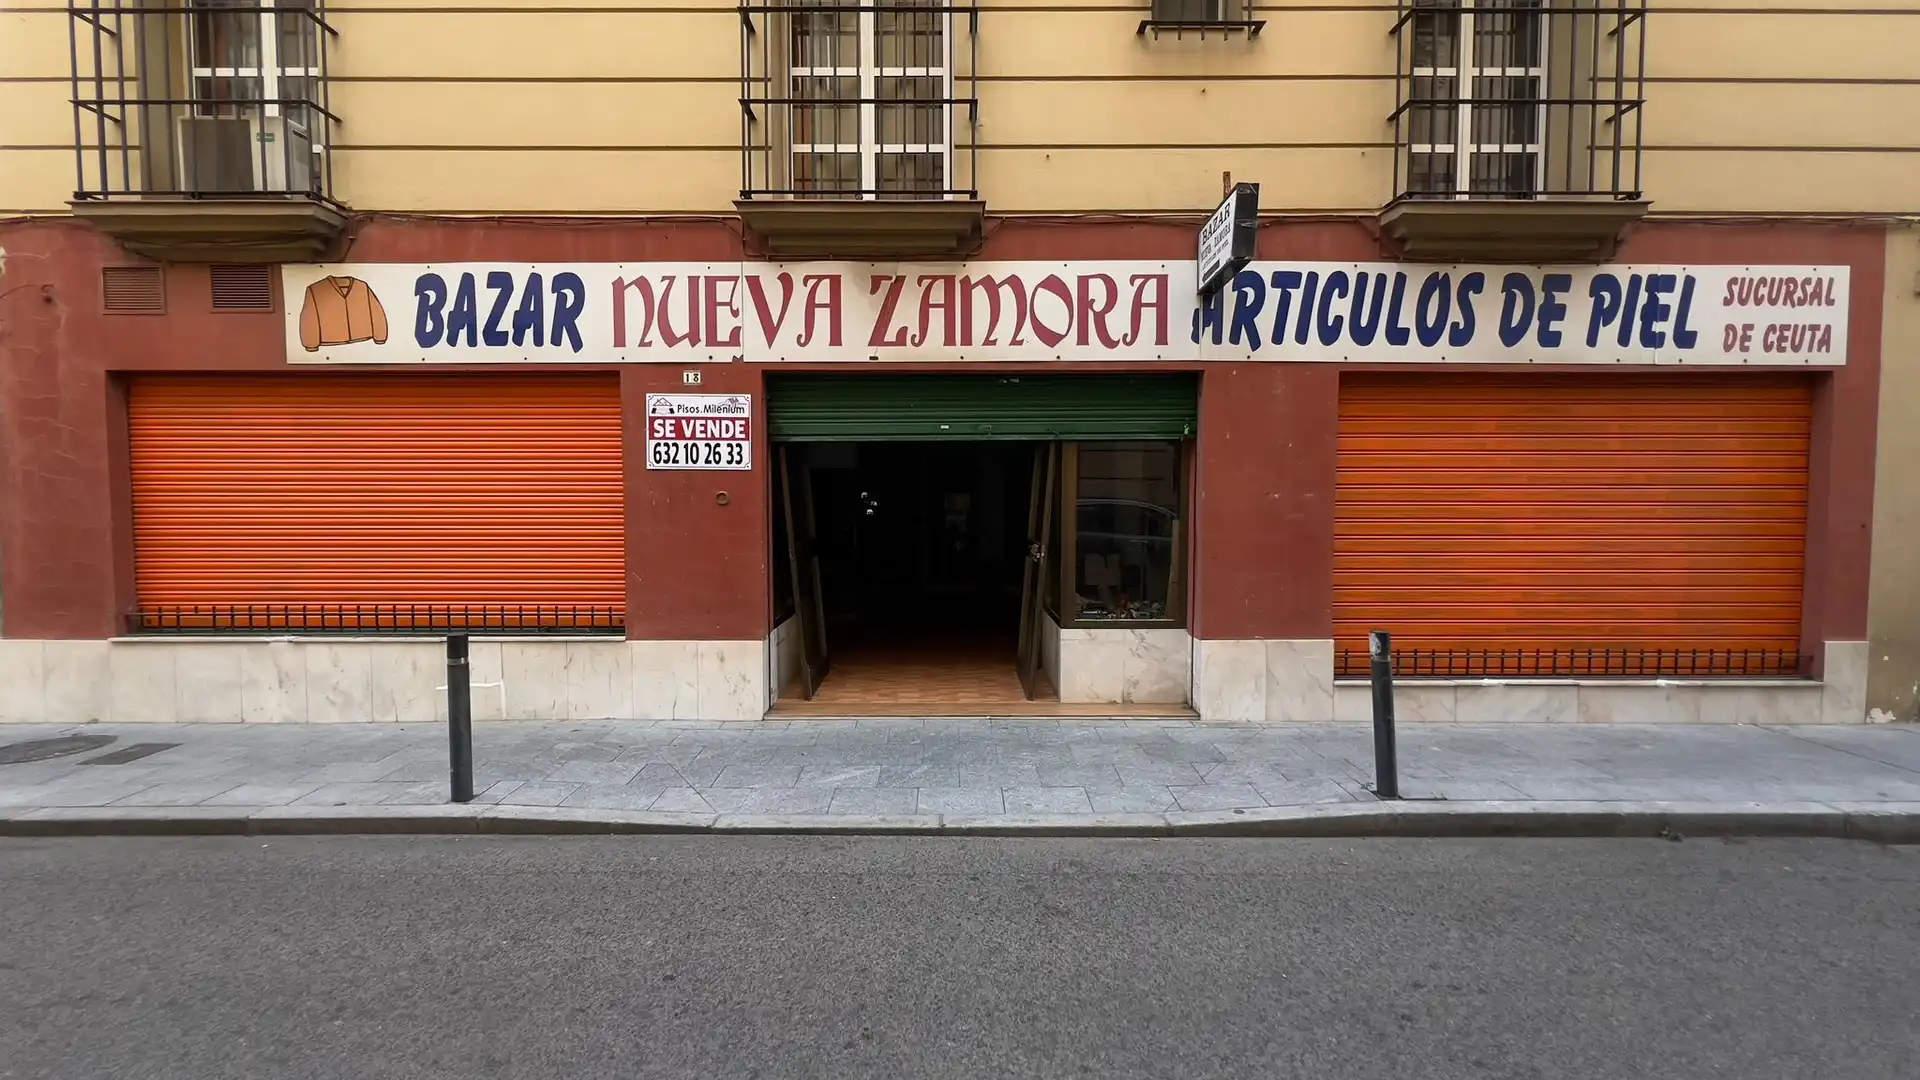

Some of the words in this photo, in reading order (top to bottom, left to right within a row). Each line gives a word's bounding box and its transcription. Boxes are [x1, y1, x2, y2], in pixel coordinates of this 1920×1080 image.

[1202, 203, 1230, 245] BAZAR
[1722, 276, 1836, 308] SUCURSAL
[414, 271, 586, 353] BAZAR
[611, 273, 843, 350] NUEVA
[867, 273, 1169, 350] ZAMORA
[1191, 270, 1485, 352] ARTICULOS
[1498, 272, 1572, 348] DE
[1586, 273, 1698, 350] PIEL
[1723, 323, 1755, 353] DE
[1763, 323, 1832, 354] CEUTA
[653, 419, 676, 438] SE
[681, 419, 746, 439] VENDE
[653, 442, 680, 465] 632
[683, 442, 700, 465] 10
[704, 442, 722, 465] 26
[726, 442, 743, 465] 33
